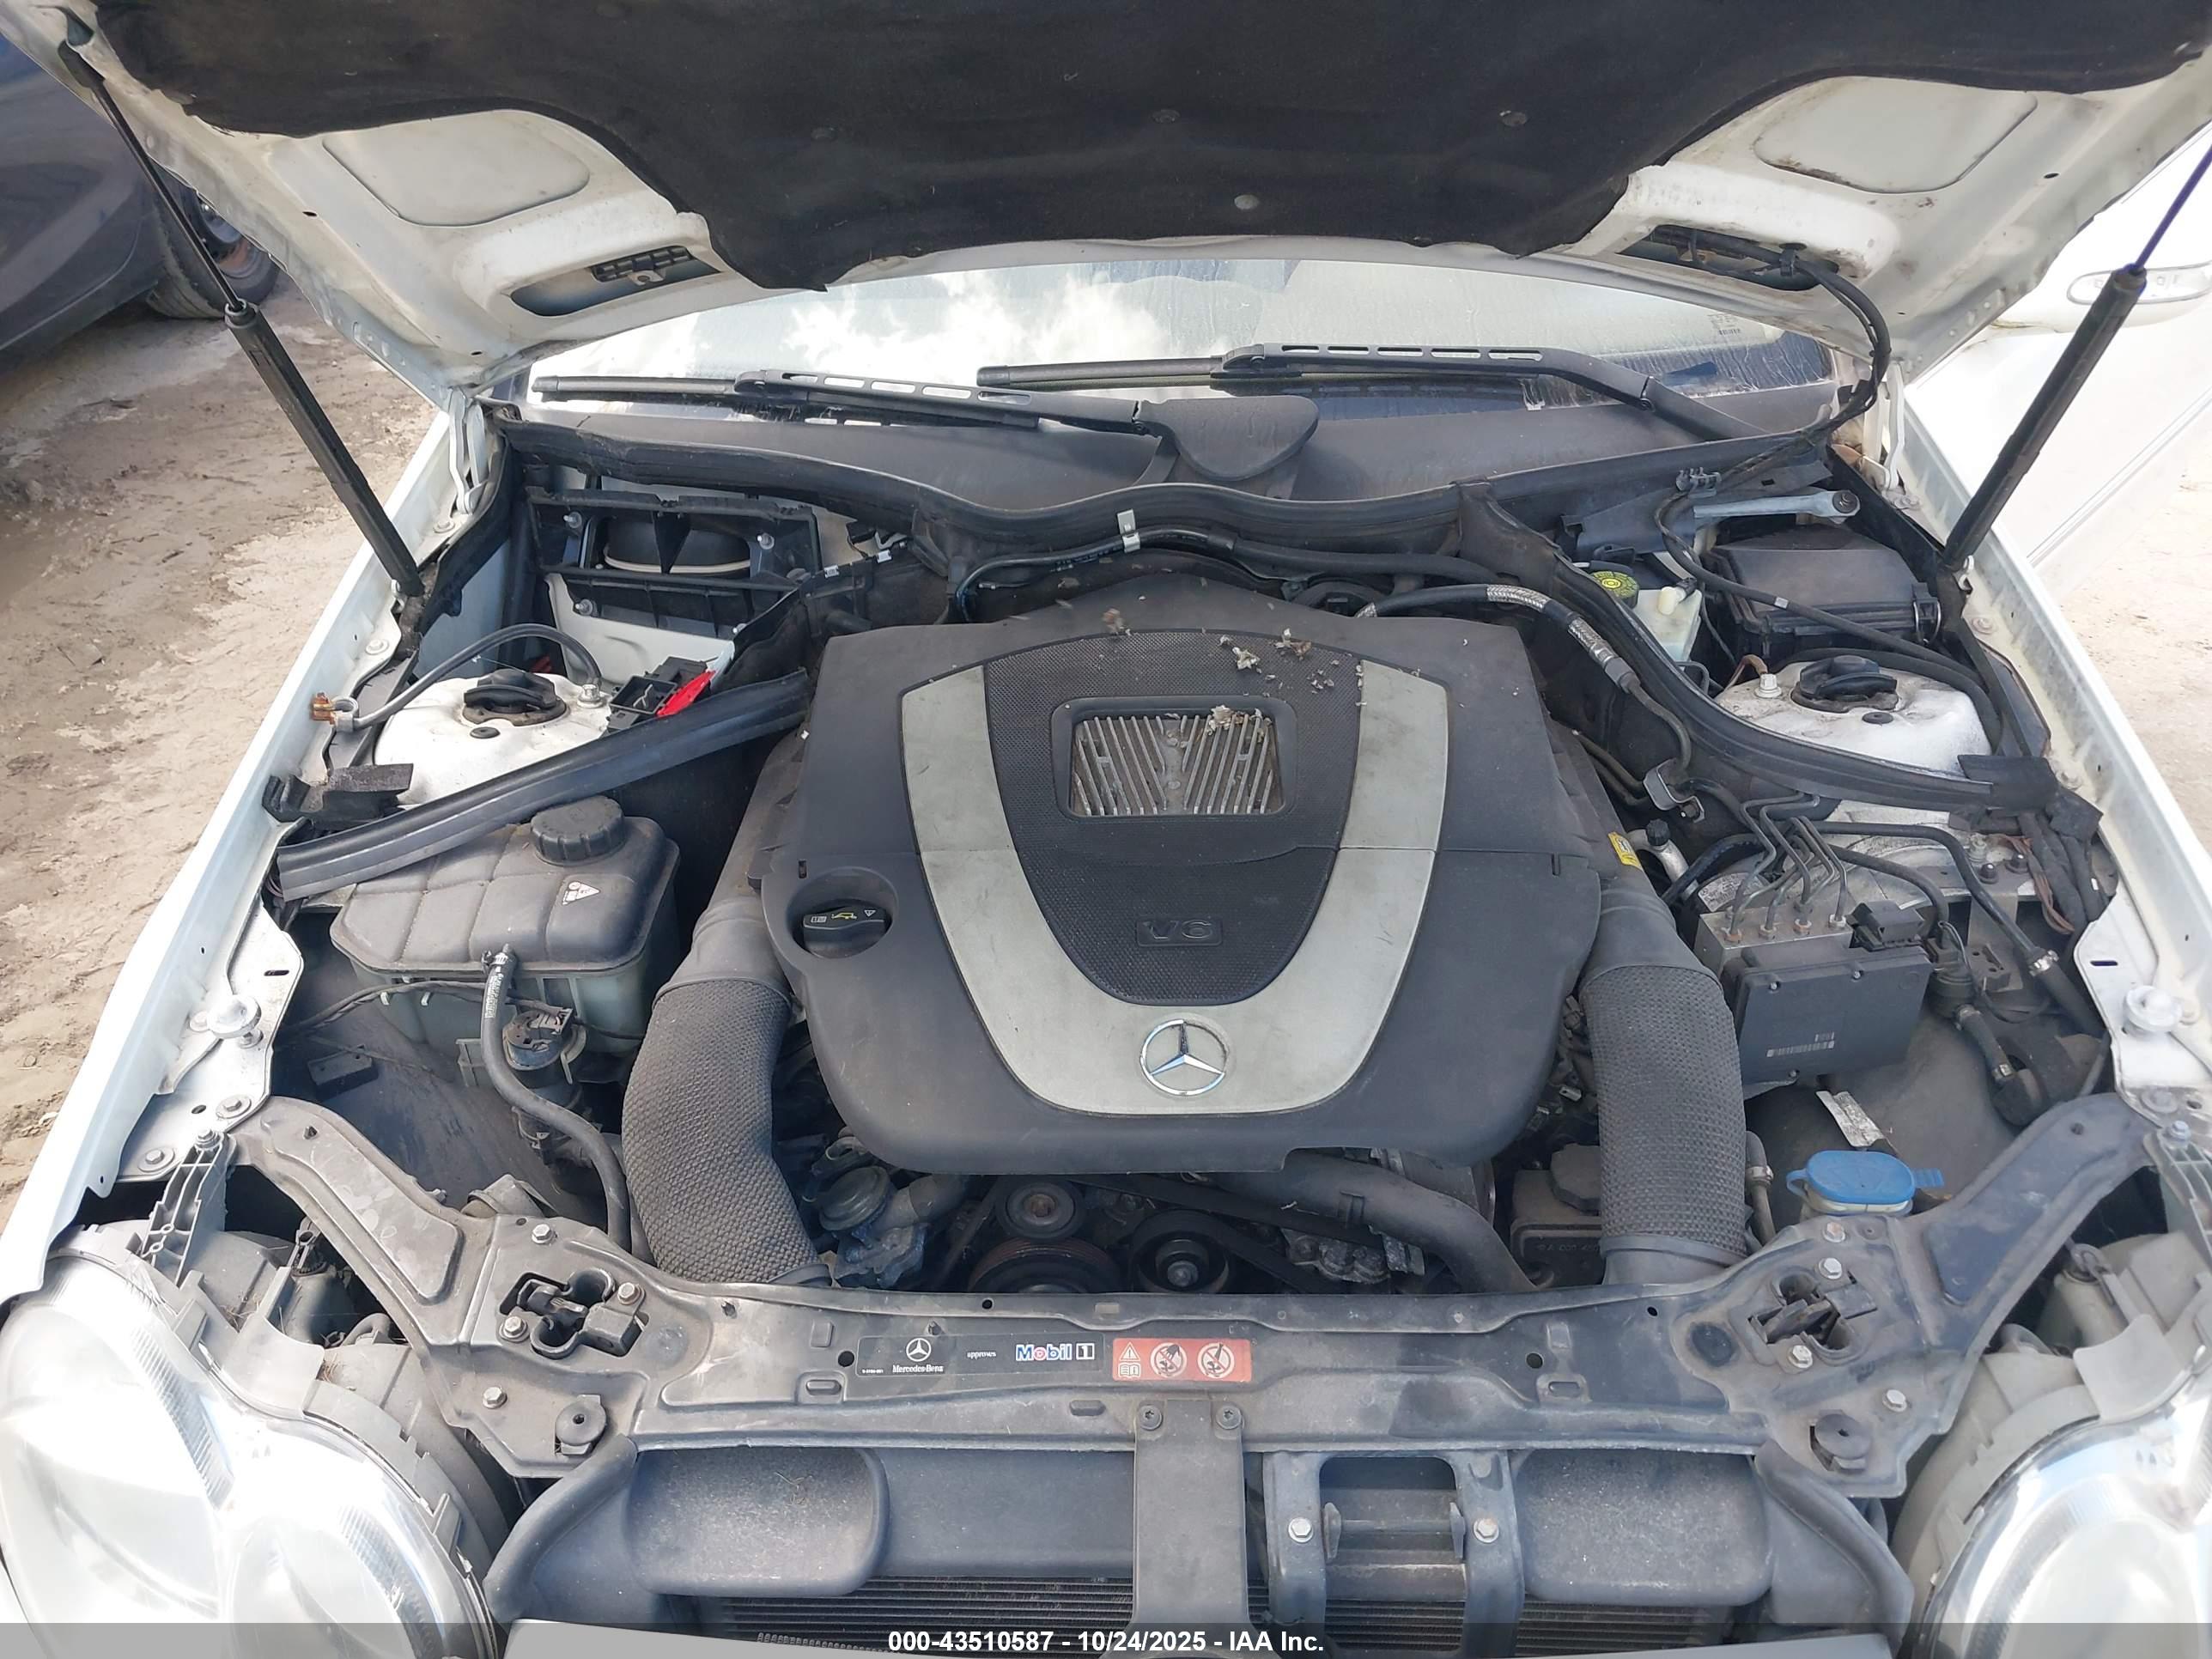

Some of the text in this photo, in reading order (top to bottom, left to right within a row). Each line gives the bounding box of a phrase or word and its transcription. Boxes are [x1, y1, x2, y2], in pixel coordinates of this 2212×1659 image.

[1142, 919, 1213, 940] V6
[892, 1364, 945, 1374] Mercedes-Benz
[966, 1351, 997, 1360] approves
[1015, 1343, 1073, 1361] Mobil
